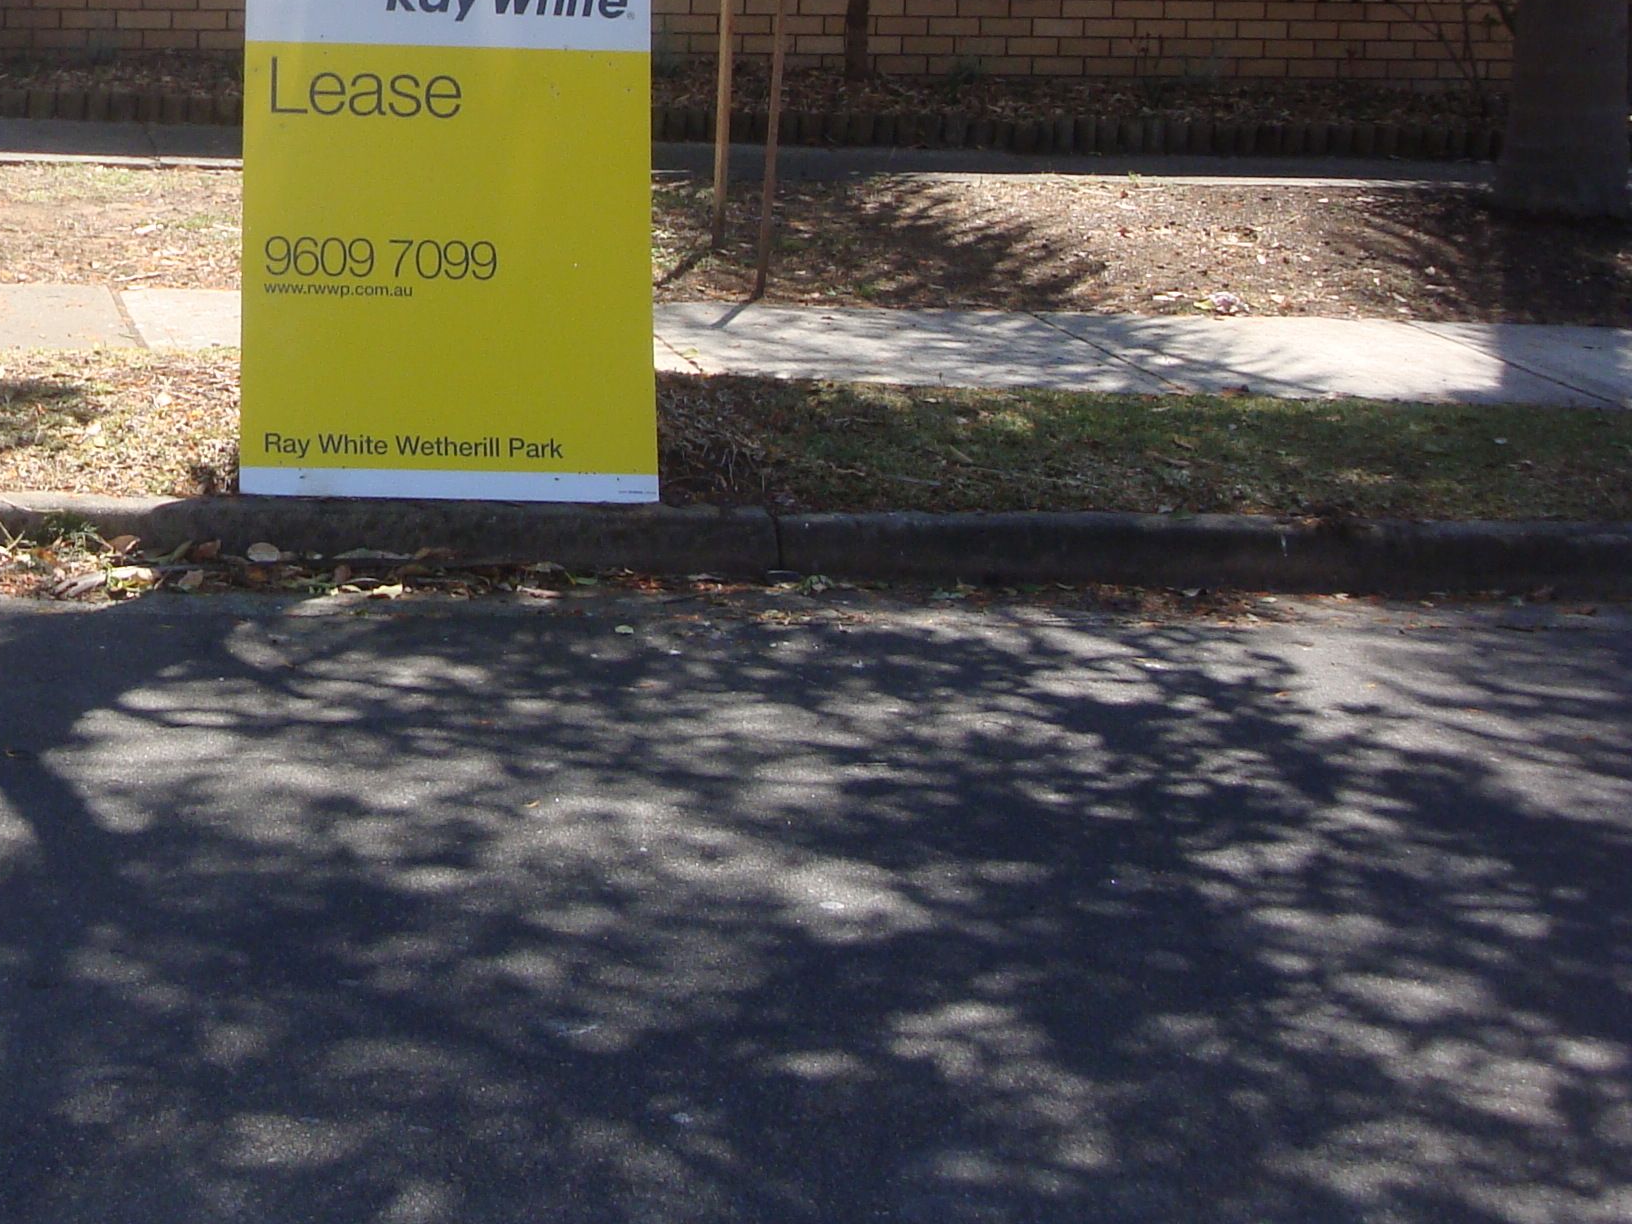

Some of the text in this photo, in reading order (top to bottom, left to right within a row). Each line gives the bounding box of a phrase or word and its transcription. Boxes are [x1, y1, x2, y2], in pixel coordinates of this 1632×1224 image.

[270, 55, 463, 119] Lease
[264, 235, 498, 281] 9609 7099
[263, 281, 414, 299] www.rwwp.com.au
[264, 432, 564, 460] Ray White Wetherill Park
